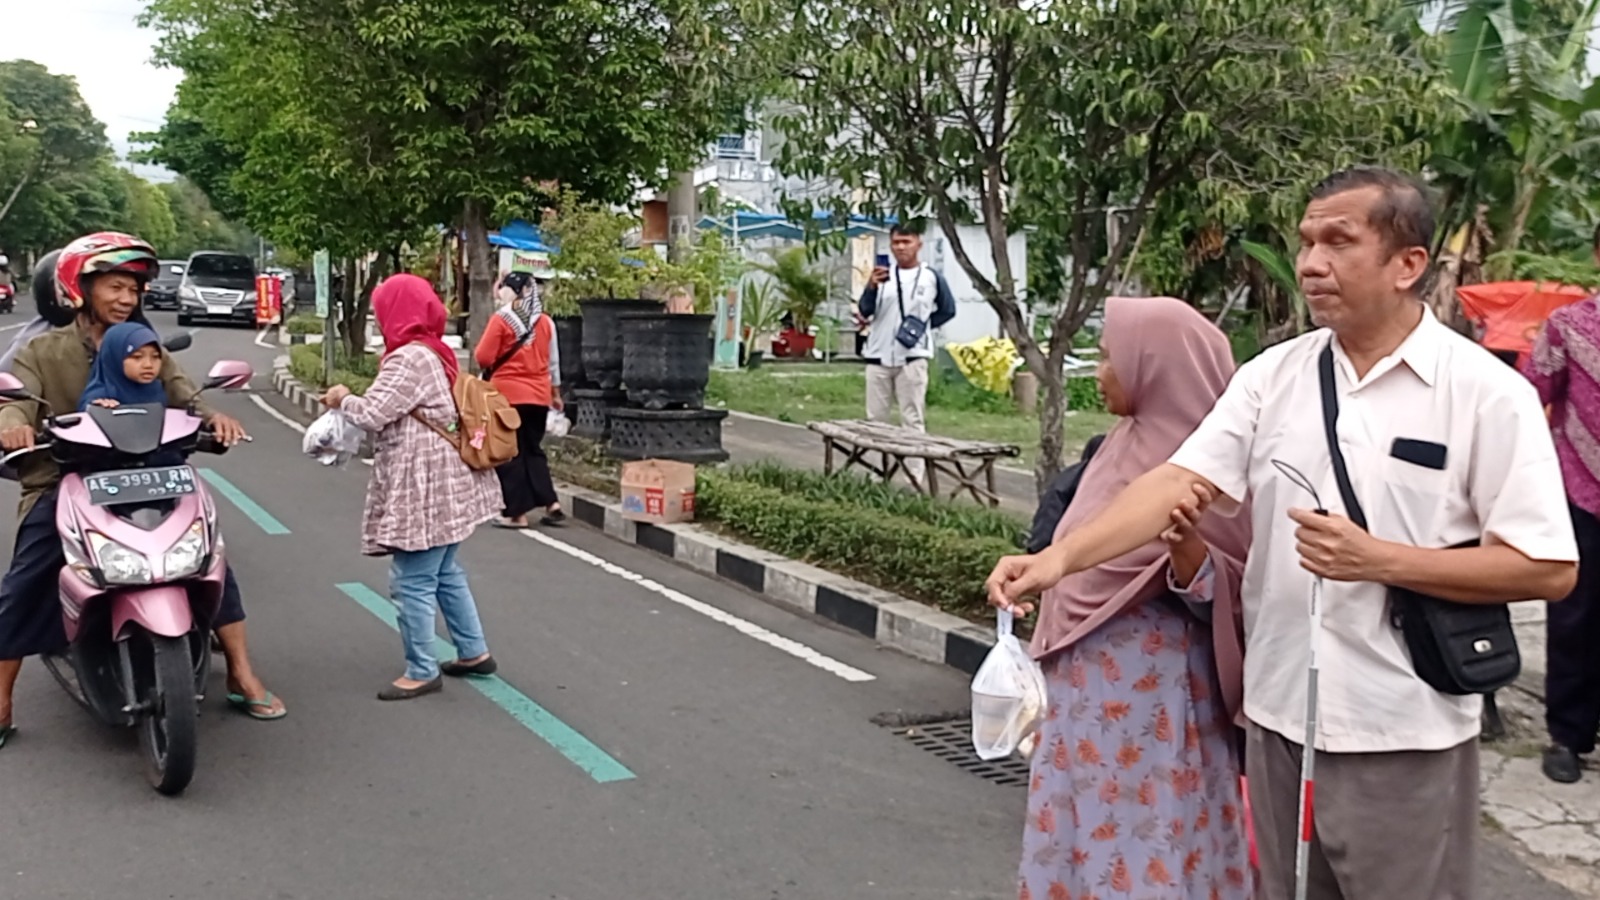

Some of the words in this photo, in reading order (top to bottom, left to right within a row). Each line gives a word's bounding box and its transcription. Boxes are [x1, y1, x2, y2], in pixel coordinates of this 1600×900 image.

[89, 477, 111, 491] AE
[120, 472, 161, 487] 3991
[168, 469, 191, 483] RN
